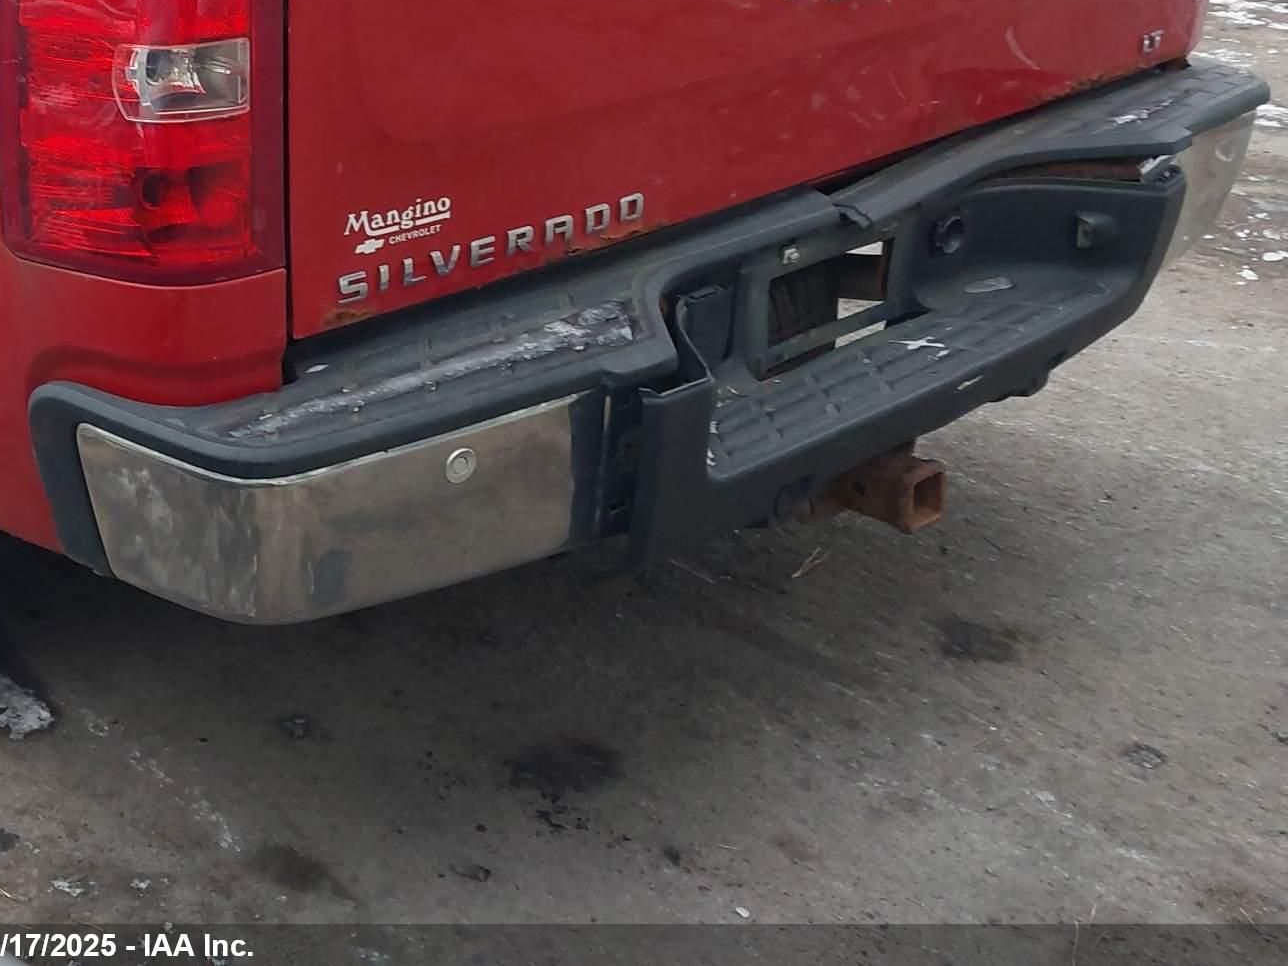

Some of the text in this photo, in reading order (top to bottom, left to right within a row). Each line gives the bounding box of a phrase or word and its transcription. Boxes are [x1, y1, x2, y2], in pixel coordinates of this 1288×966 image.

[1142, 30, 1164, 53] LT
[343, 197, 451, 236] Mangino
[337, 192, 644, 304] SILVERADO
[388, 224, 442, 244] CHEVROLET
